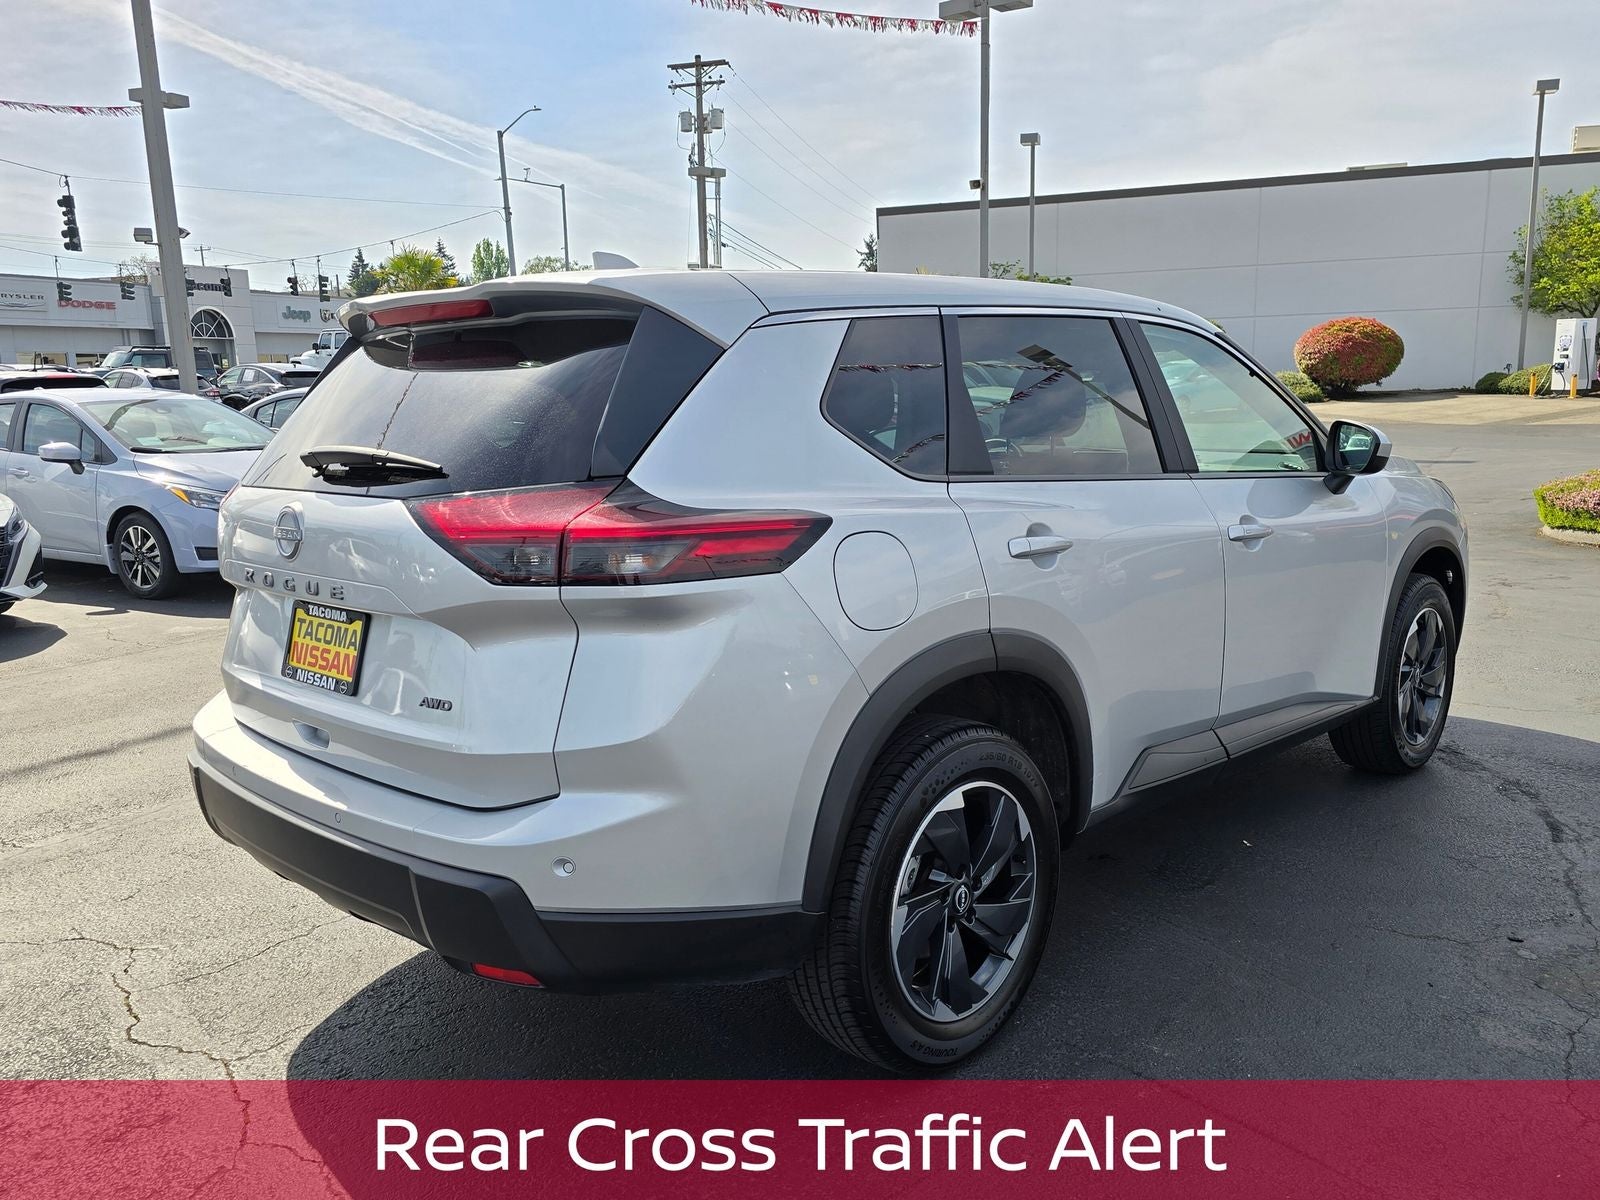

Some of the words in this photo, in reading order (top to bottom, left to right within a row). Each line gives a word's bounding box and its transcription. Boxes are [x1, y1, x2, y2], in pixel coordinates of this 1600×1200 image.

[57, 300, 116, 309] DODGE
[282, 305, 311, 323] Jeep
[245, 567, 344, 600] ROGUE
[308, 604, 347, 622] TACOMA
[297, 617, 358, 651] TACOMA
[291, 640, 357, 678] NISSAN
[296, 669, 336, 690] NISSAN
[419, 696, 453, 711] AWD
